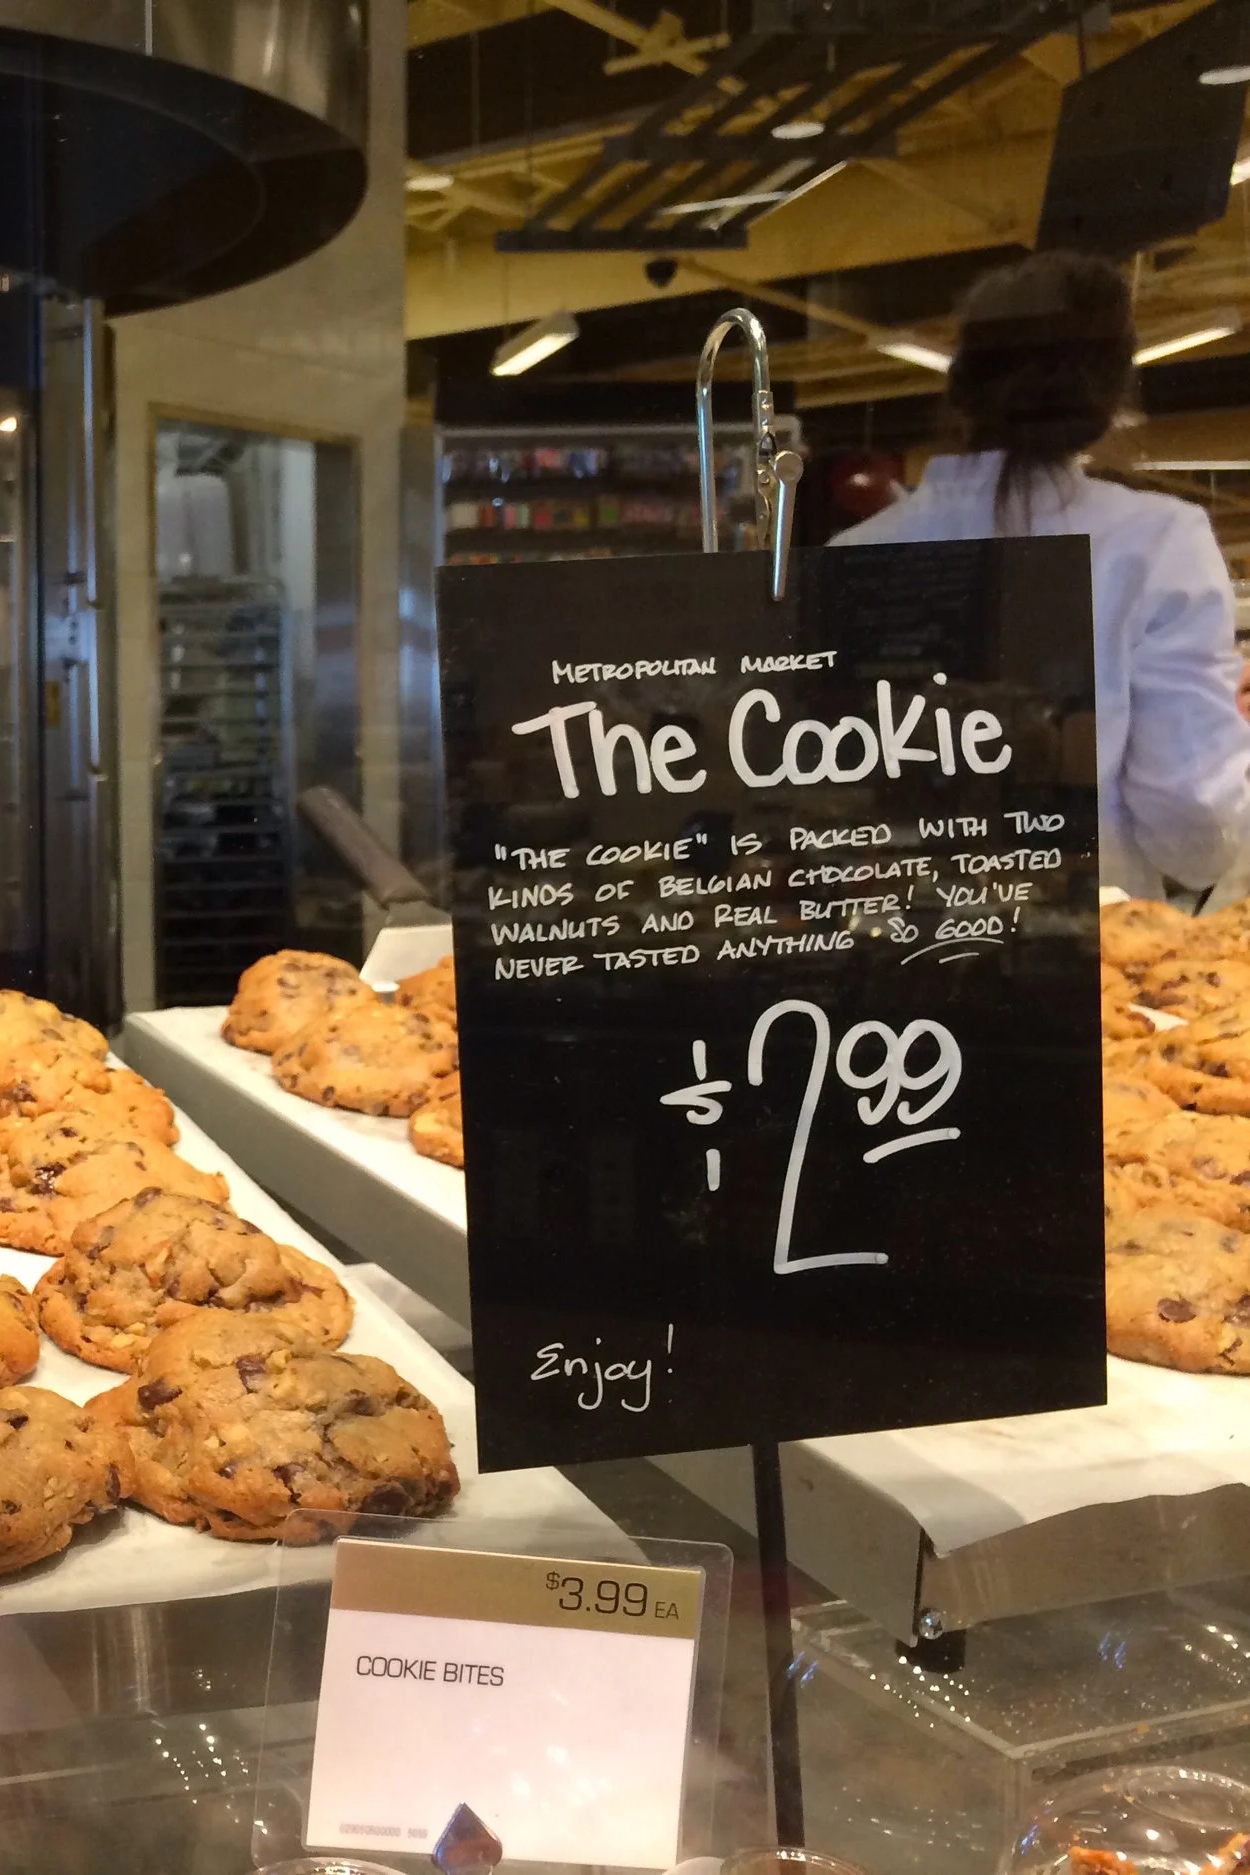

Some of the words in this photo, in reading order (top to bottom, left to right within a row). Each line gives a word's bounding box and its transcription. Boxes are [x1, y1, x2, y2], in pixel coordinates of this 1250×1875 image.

[551, 656, 717, 685] METROPOLITAN
[740, 650, 838, 674] MARKET
[511, 700, 707, 799] The
[728, 672, 1012, 788] Cookie
[730, 832, 763, 856] IS
[789, 823, 892, 851] PACKED
[918, 816, 987, 839] WITH
[1003, 810, 1065, 834] TWO
[488, 882, 574, 911] KINDS
[594, 879, 635, 902] OF
[658, 870, 772, 898] BELGIAN
[787, 856, 940, 888] CHOCOLATE,
[950, 847, 1062, 875] TOASTED
[490, 915, 620, 946] WALNUTS
[641, 910, 694, 934] AND
[714, 903, 778, 928] REAL
[799, 884, 915, 921] BUTTER!
[935, 881, 1033, 908] YOU'VE
[495, 955, 584, 980] NEVER
[592, 944, 700, 971] TASTED
[716, 929, 855, 961] ANYTHING
[935, 906, 1021, 941] GOOD!
[530, 1323, 674, 1412] Enjoy!
[545, 1570, 648, 1617] $3.99
[654, 1600, 680, 1621] EA
[356, 1655, 437, 1682] COOKIE
[443, 1662, 505, 1687] BITES
